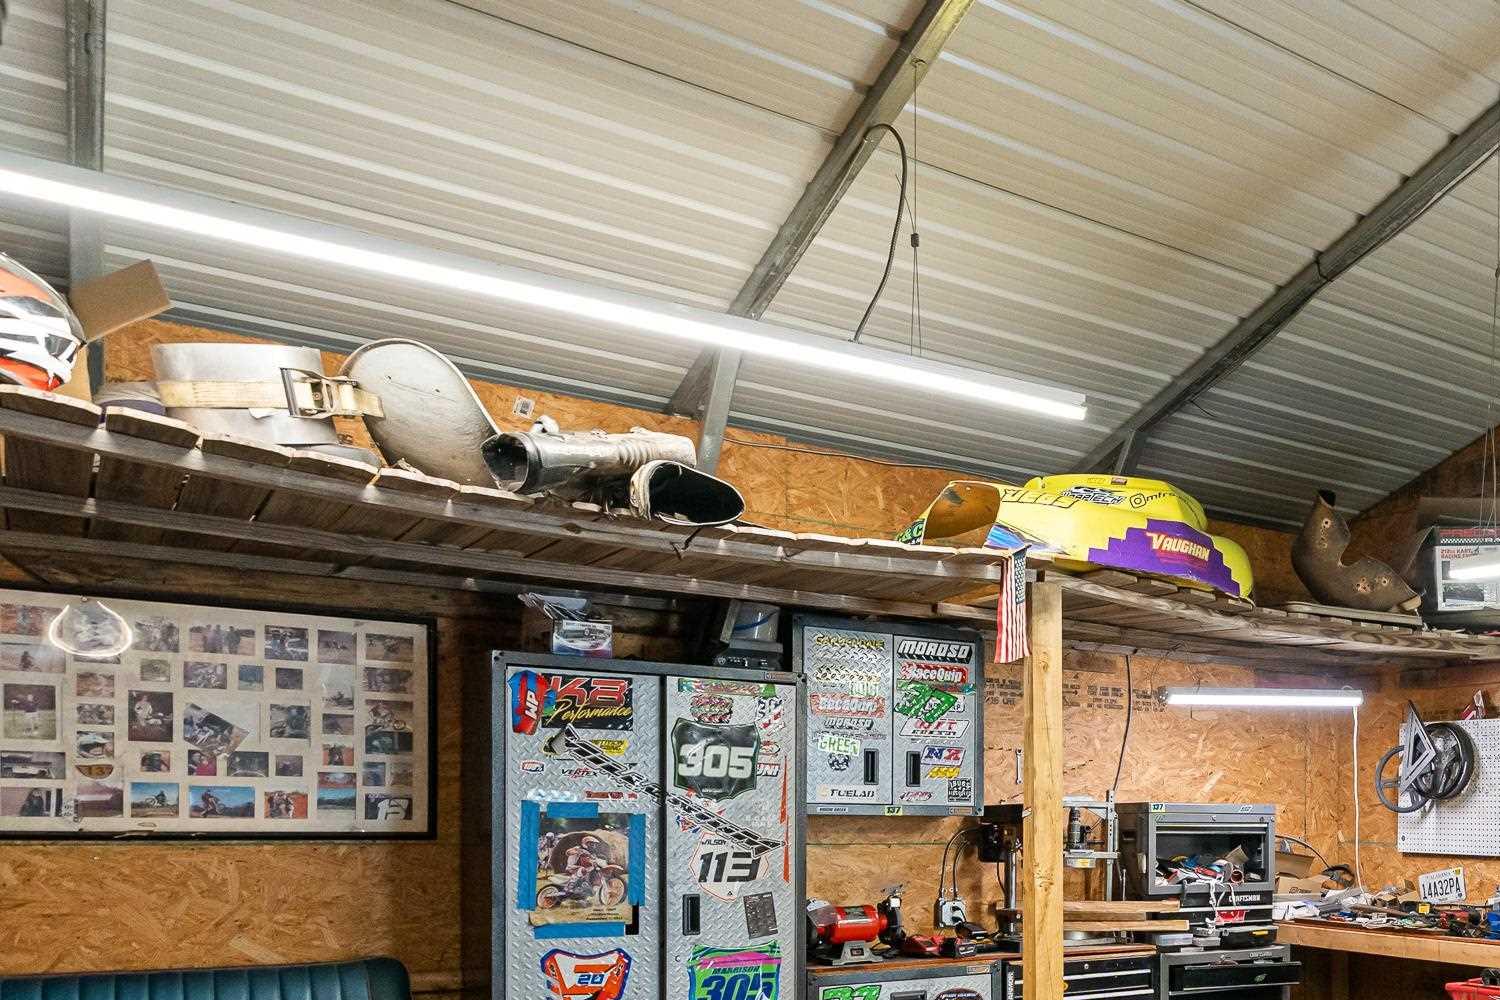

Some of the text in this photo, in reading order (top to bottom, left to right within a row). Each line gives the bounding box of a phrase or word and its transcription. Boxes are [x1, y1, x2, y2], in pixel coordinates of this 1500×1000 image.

[1149, 532, 1210, 561] VAUGHAN
[898, 639, 972, 660] MOROSO
[525, 690, 538, 720] WP
[545, 698, 632, 725] Performance
[678, 744, 754, 779] 305
[699, 851, 761, 882] 113
[1422, 877, 1461, 899] 14A32PA
[577, 972, 605, 986] 20
